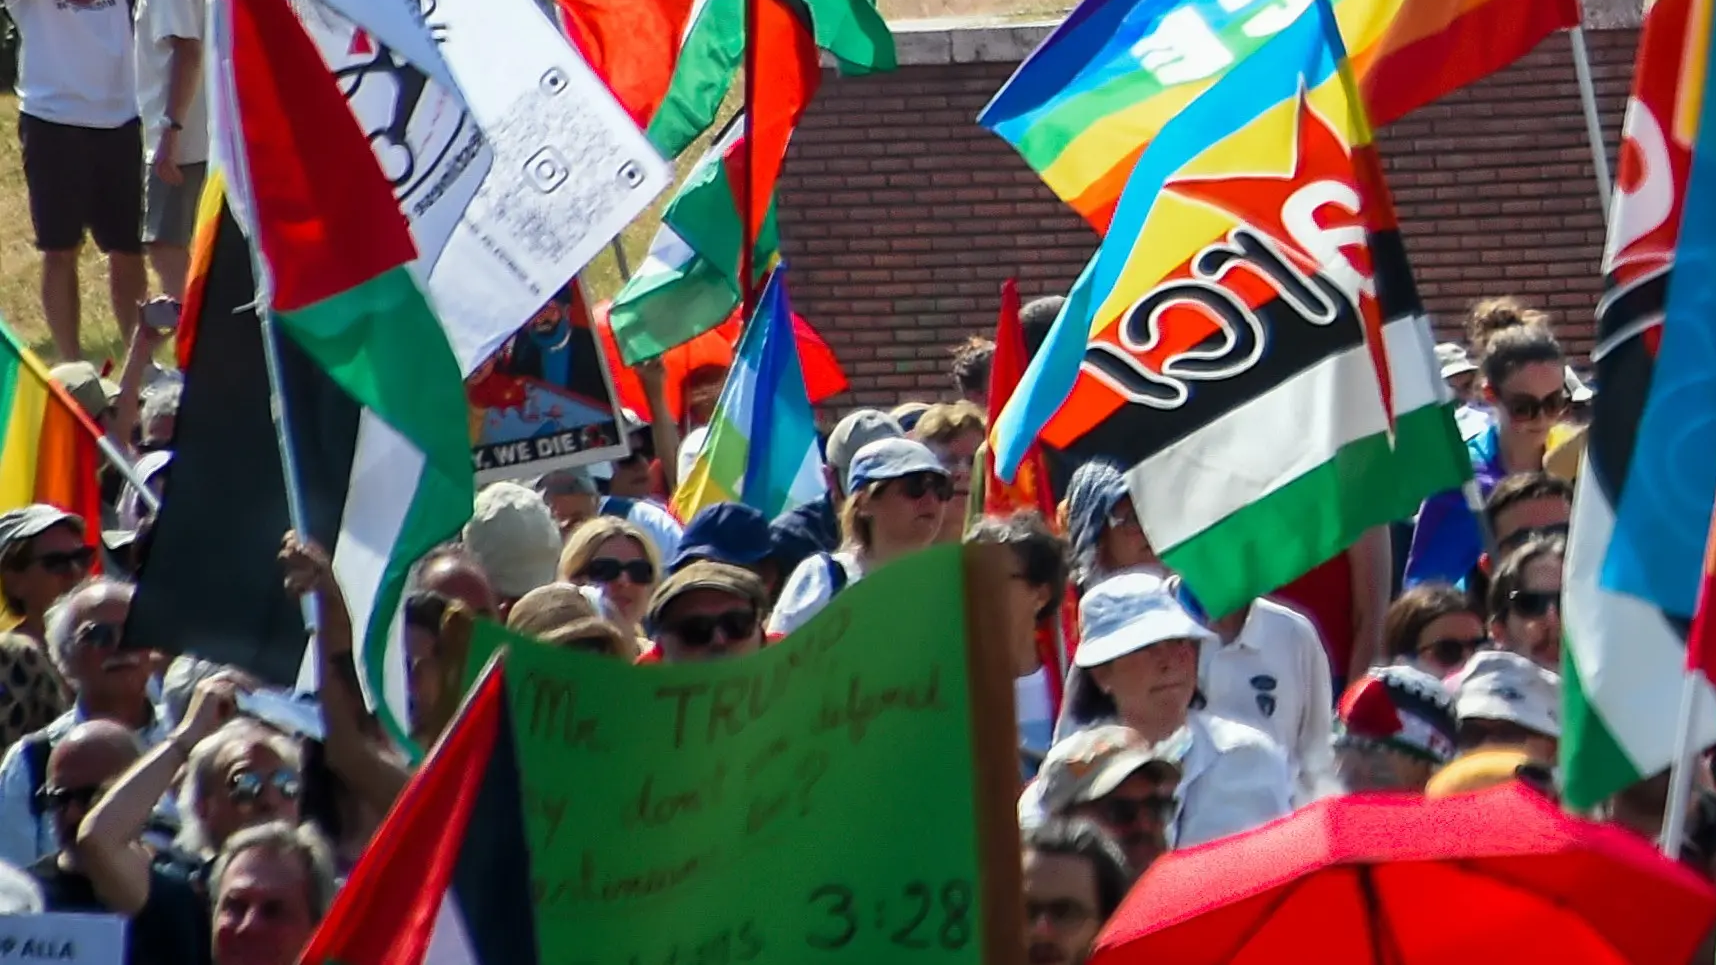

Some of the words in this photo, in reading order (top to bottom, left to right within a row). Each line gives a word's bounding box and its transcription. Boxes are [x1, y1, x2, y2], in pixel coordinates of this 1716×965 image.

[494, 441, 532, 465] WE
[537, 432, 577, 456] DIE
[805, 877, 972, 952] 3:28
